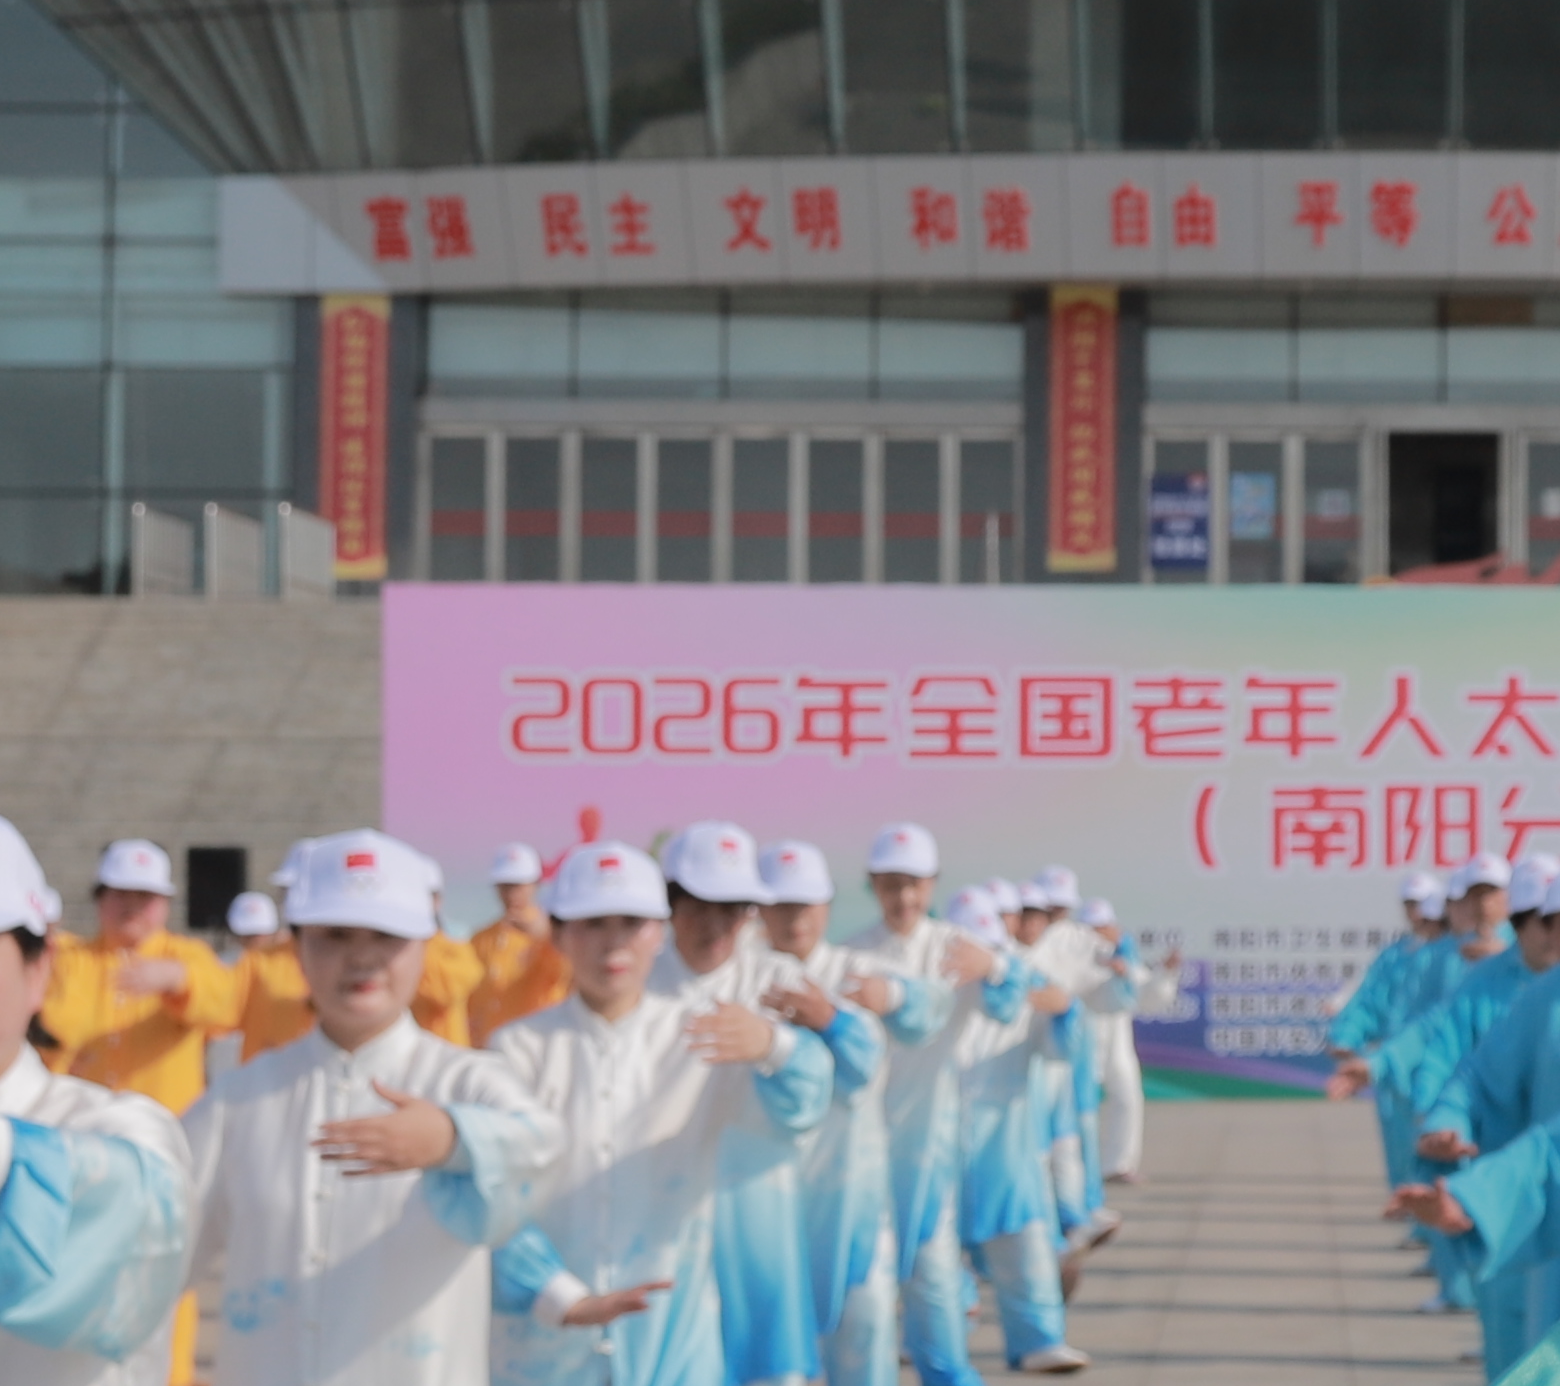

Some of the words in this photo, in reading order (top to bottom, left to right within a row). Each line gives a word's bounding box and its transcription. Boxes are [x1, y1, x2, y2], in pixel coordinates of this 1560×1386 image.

[364, 196, 473, 260] 富强
[541, 194, 654, 255] 民主
[724, 187, 841, 250] 文明
[910, 187, 1030, 251] 和谐
[1108, 182, 1217, 246] 自由
[1295, 181, 1418, 246] 平等
